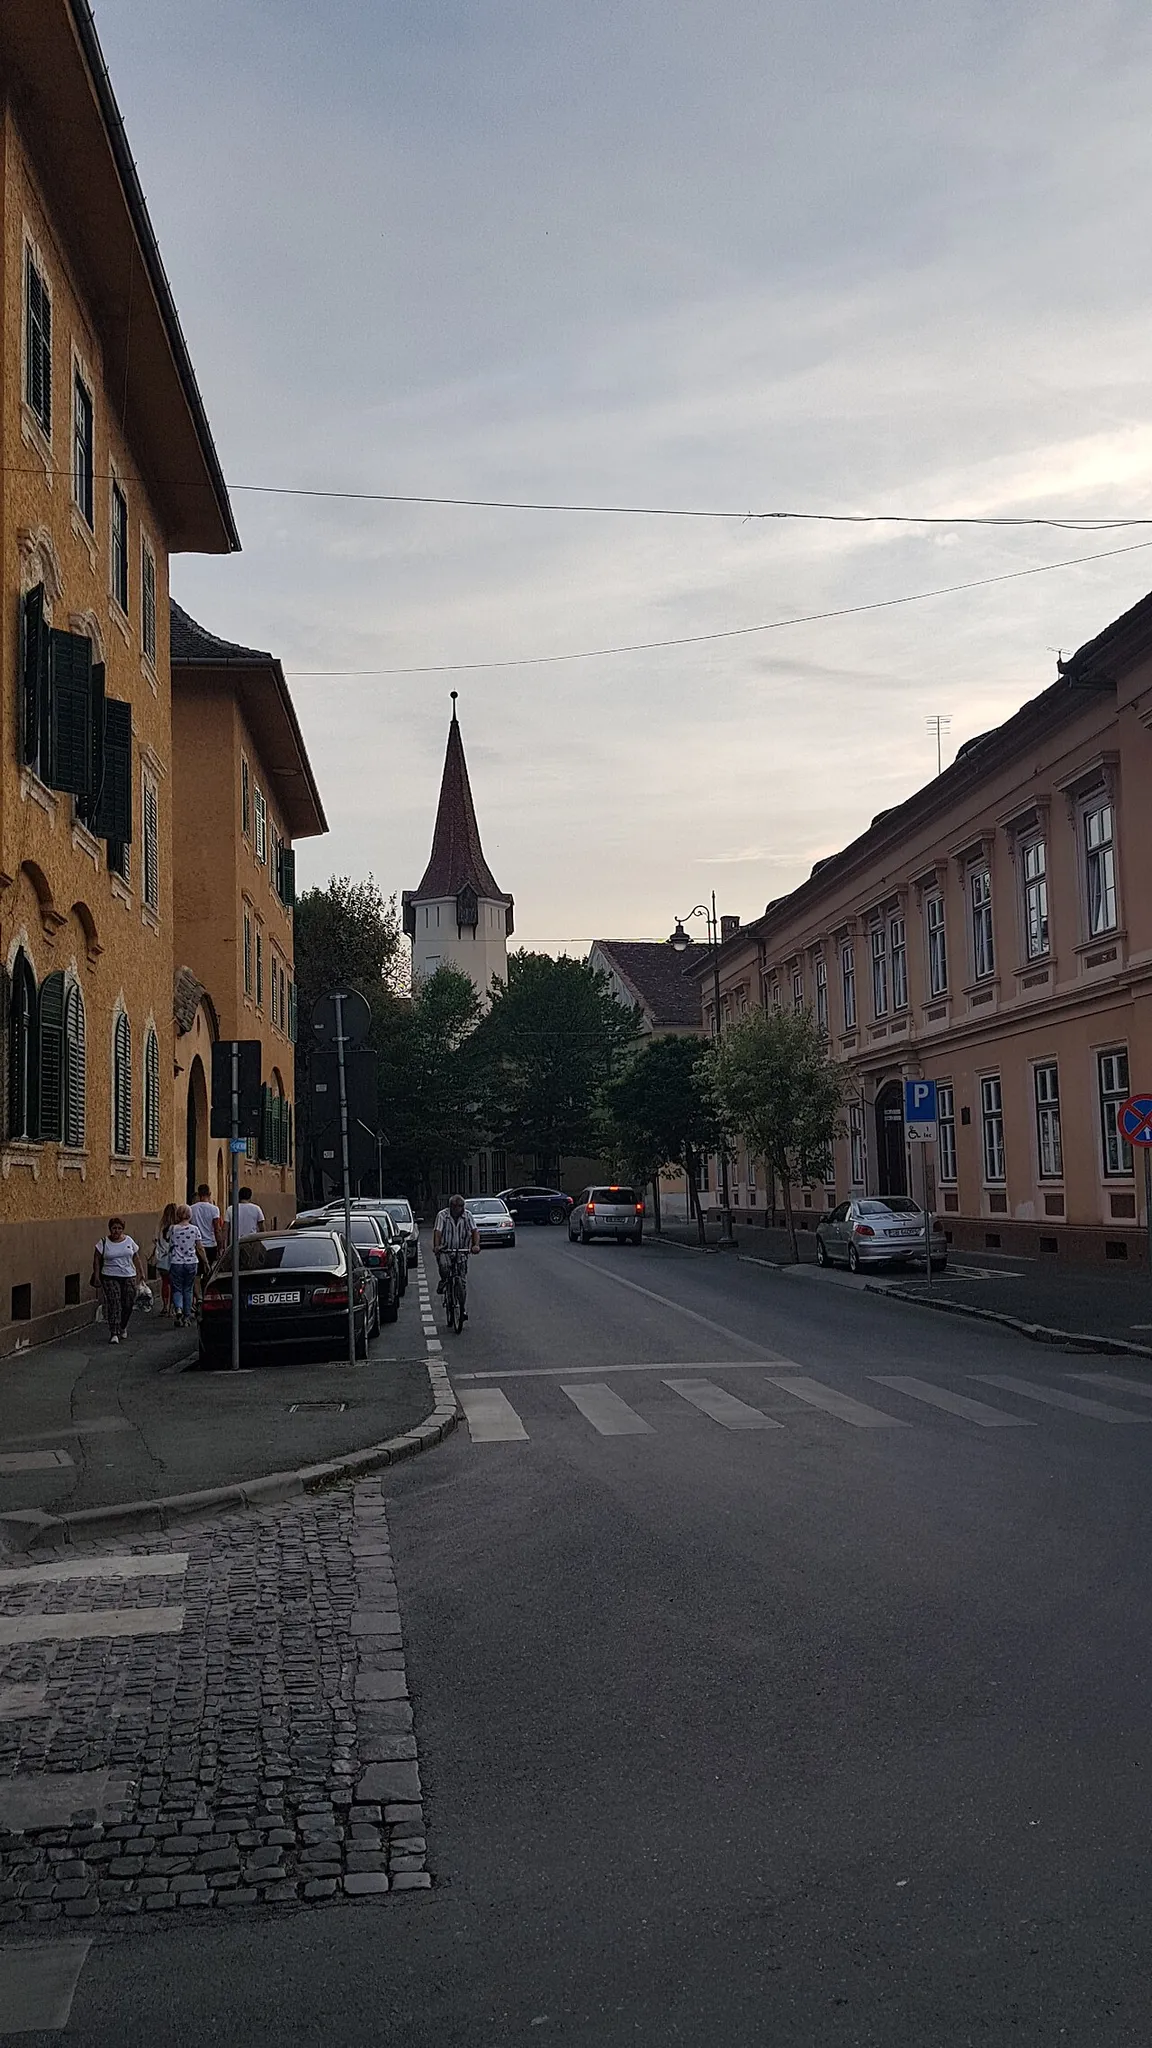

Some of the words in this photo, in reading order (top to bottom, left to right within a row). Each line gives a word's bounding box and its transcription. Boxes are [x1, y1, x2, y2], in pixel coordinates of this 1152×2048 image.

[914, 1083, 929, 1108] P
[252, 1294, 266, 1304] SB
[268, 1292, 299, 1303] 07EEE
